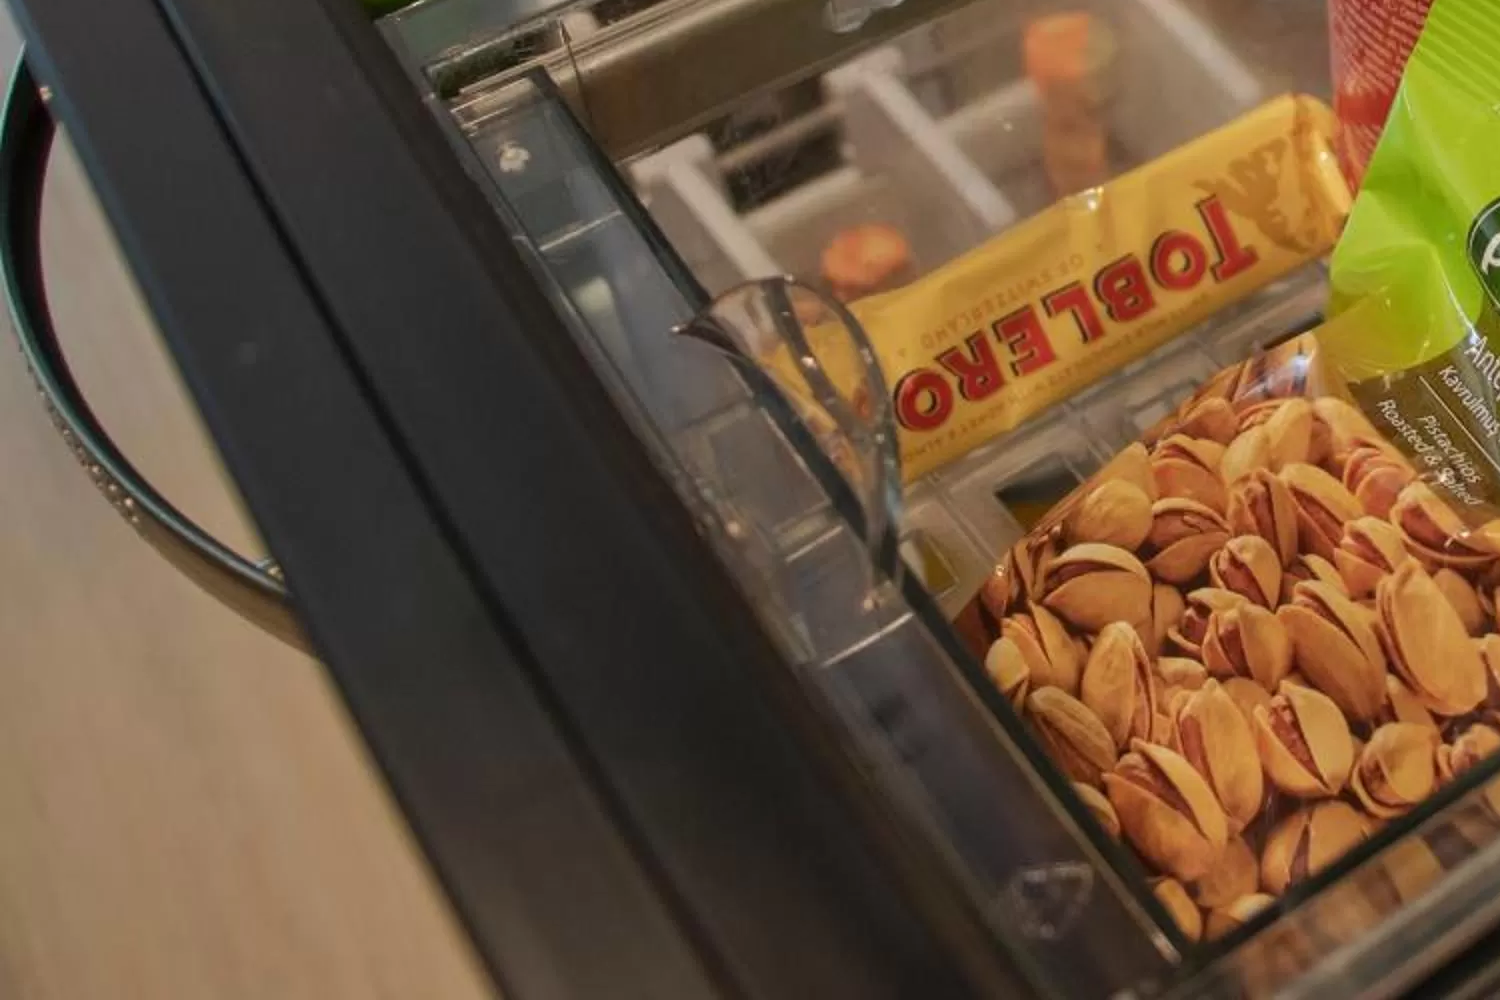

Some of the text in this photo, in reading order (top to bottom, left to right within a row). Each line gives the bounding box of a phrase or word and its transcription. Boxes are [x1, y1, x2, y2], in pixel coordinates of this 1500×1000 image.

[1376, 399, 1435, 453] Roasted
[1423, 454, 1443, 466] &
[1439, 365, 1500, 439] Kavrulmuş
[1416, 415, 1482, 483] Pistachios
